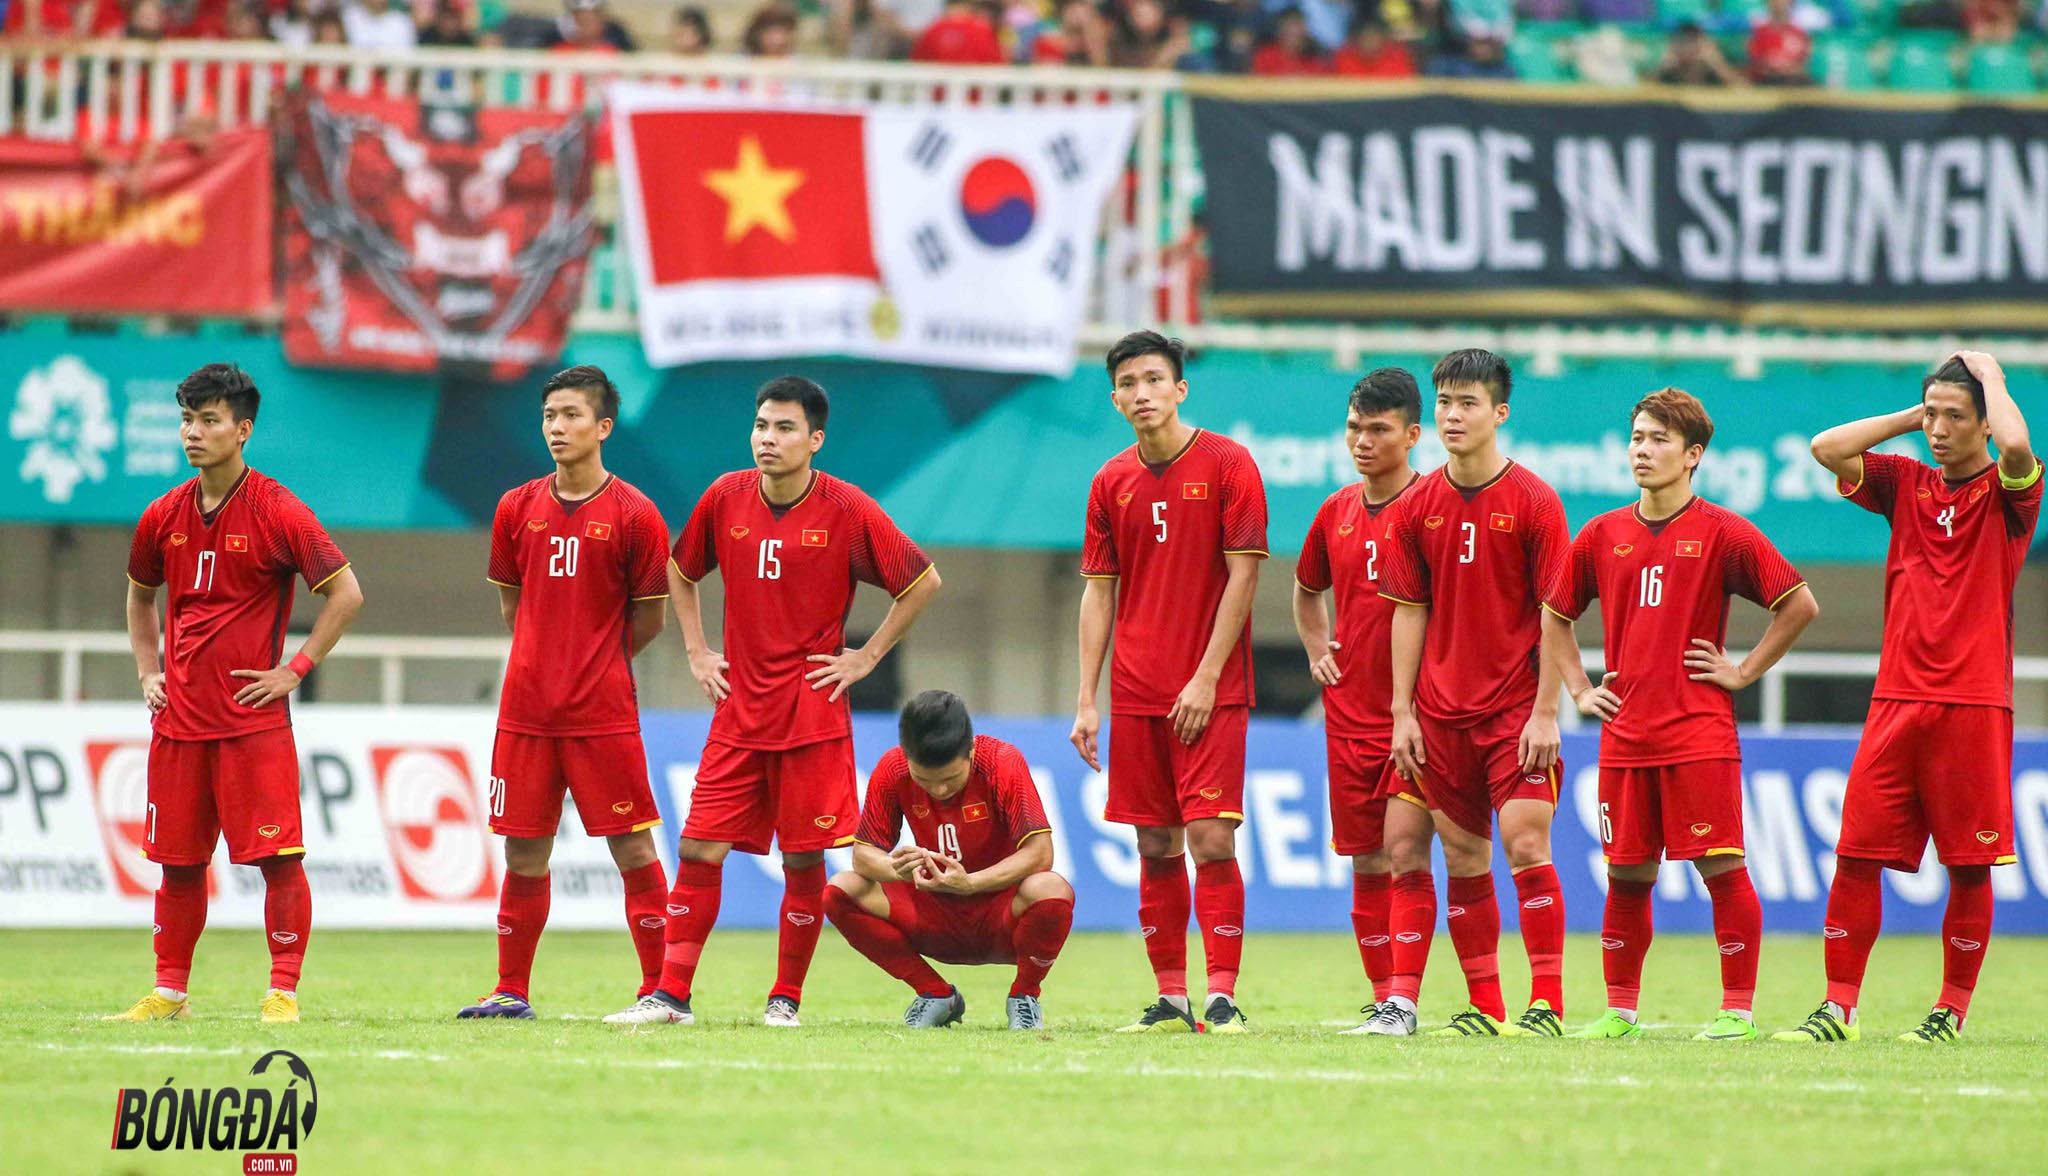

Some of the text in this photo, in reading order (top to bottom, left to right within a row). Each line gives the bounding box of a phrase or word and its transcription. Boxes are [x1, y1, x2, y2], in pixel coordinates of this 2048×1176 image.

[1268, 124, 2048, 285] MADE IN SEONGN
[1151, 501, 1167, 543] 5
[1459, 521, 1476, 563] 3
[1936, 505, 1955, 537] 4
[193, 550, 216, 592] 17
[548, 535, 579, 577] 20
[758, 538, 783, 580] 15
[1365, 540, 1378, 580] 2
[1639, 565, 1664, 608] 16
[147, 802, 157, 844] 7
[937, 823, 963, 862] 19
[1600, 802, 1613, 844] 6
